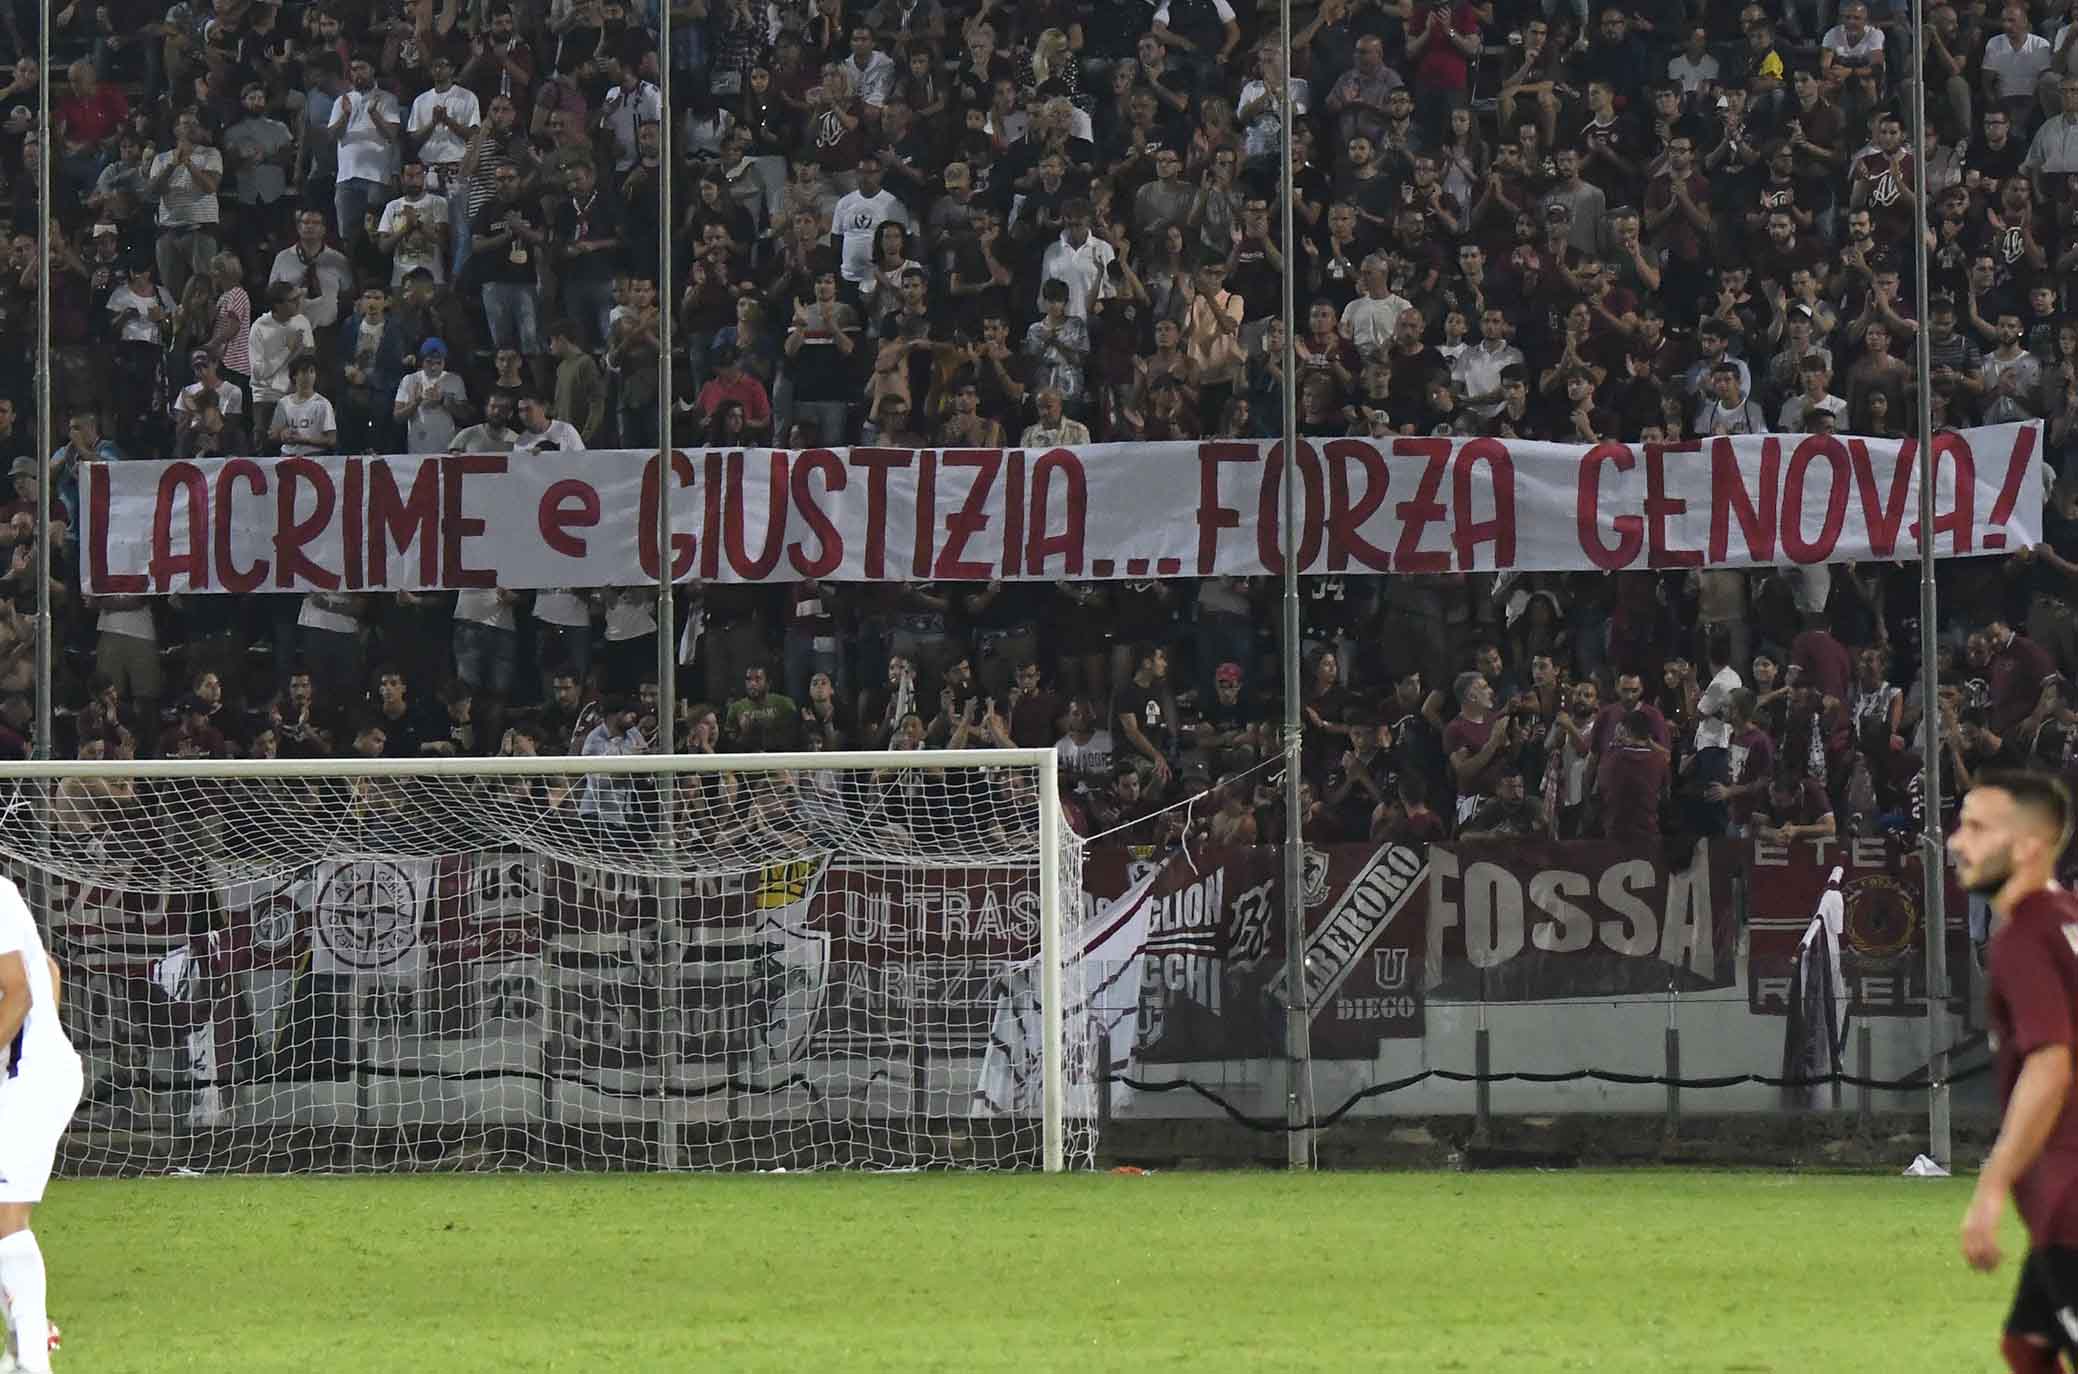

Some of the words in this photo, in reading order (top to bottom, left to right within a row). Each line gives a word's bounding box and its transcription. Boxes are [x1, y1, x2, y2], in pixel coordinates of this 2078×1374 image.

[87, 456, 507, 594] LACRIME
[538, 478, 600, 558] e
[637, 447, 1181, 581] GIUSTIZIA...
[1196, 437, 1516, 573] FORZA
[1577, 426, 2036, 570] GENOVA!
[847, 888, 1041, 943] ULTRAS
[1274, 845, 1421, 1008] LBERORO
[1425, 843, 1715, 992] FOSSA
[844, 959, 1010, 1010] AREZZ
[1336, 996, 1417, 1020] DIEGO
